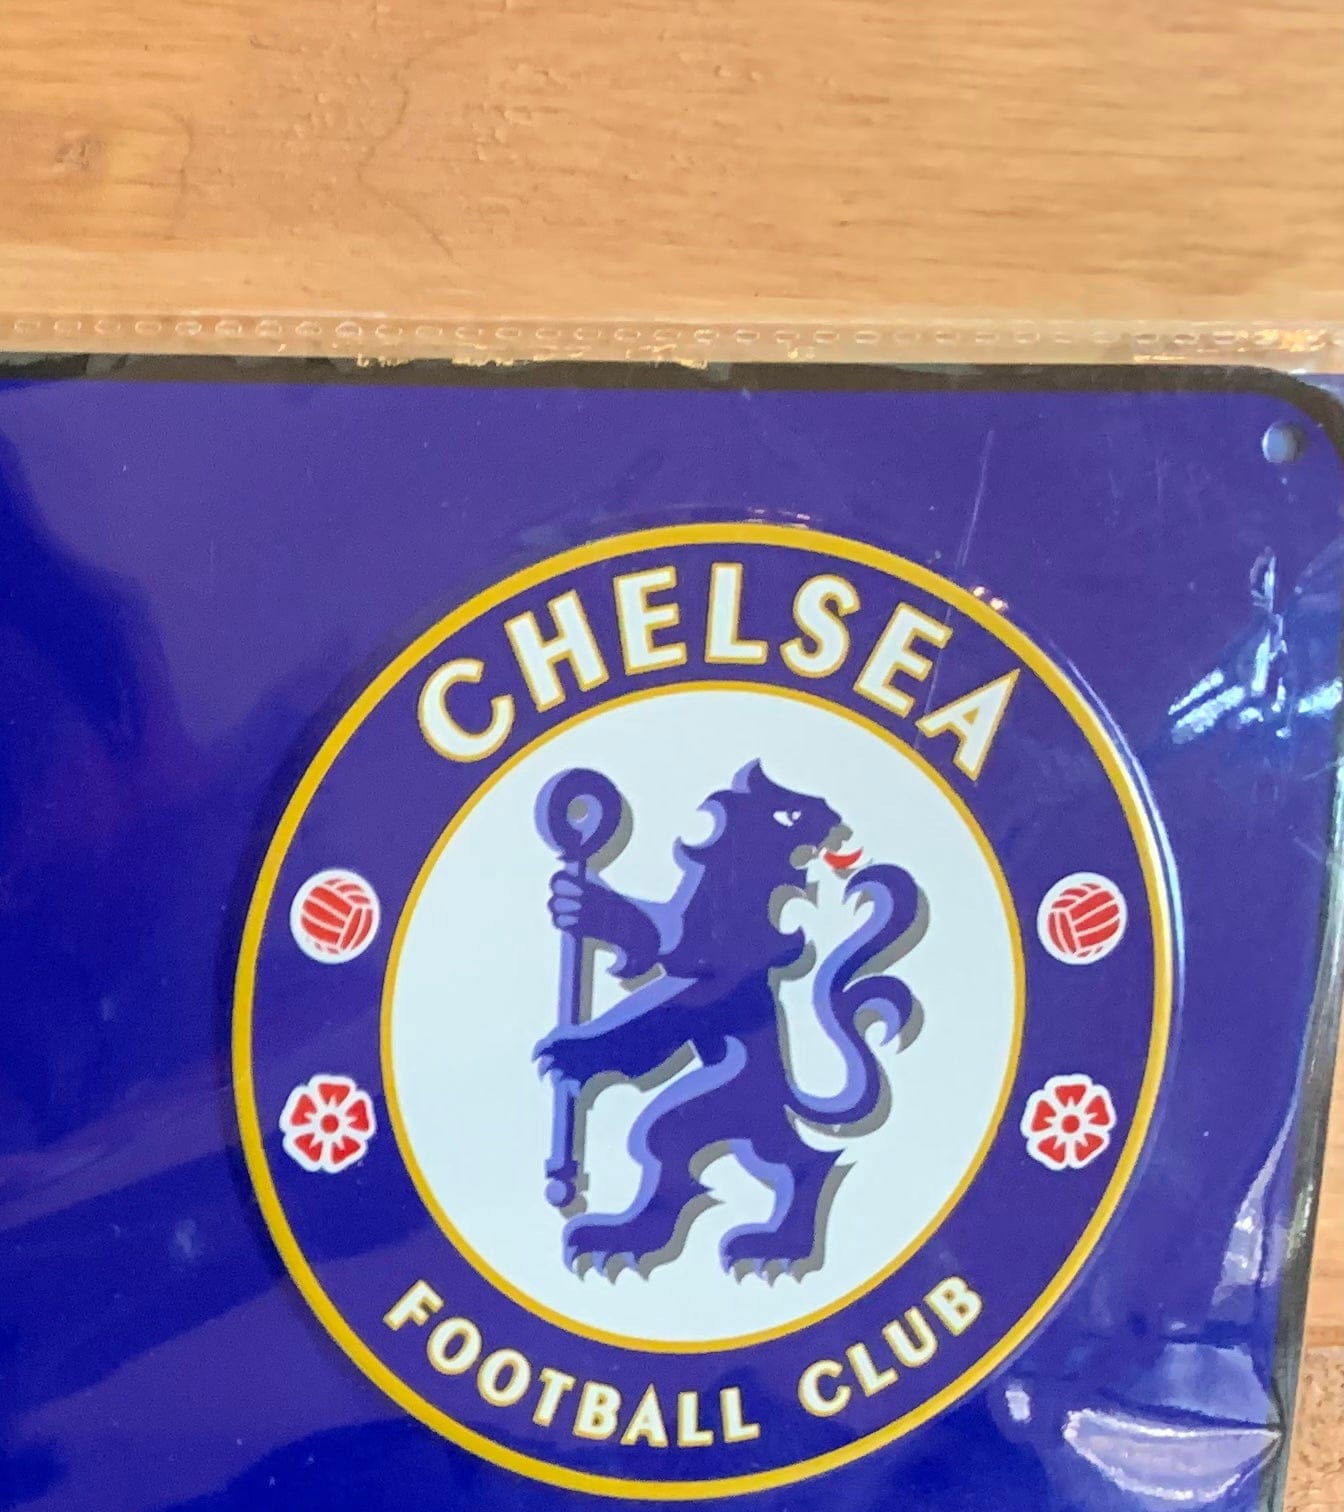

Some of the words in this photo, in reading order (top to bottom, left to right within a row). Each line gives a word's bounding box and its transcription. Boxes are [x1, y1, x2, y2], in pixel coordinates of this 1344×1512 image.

[415, 562, 1021, 779] CHELSEA
[383, 1278, 760, 1449] FOOTBALL
[796, 1273, 985, 1418] CLUB
